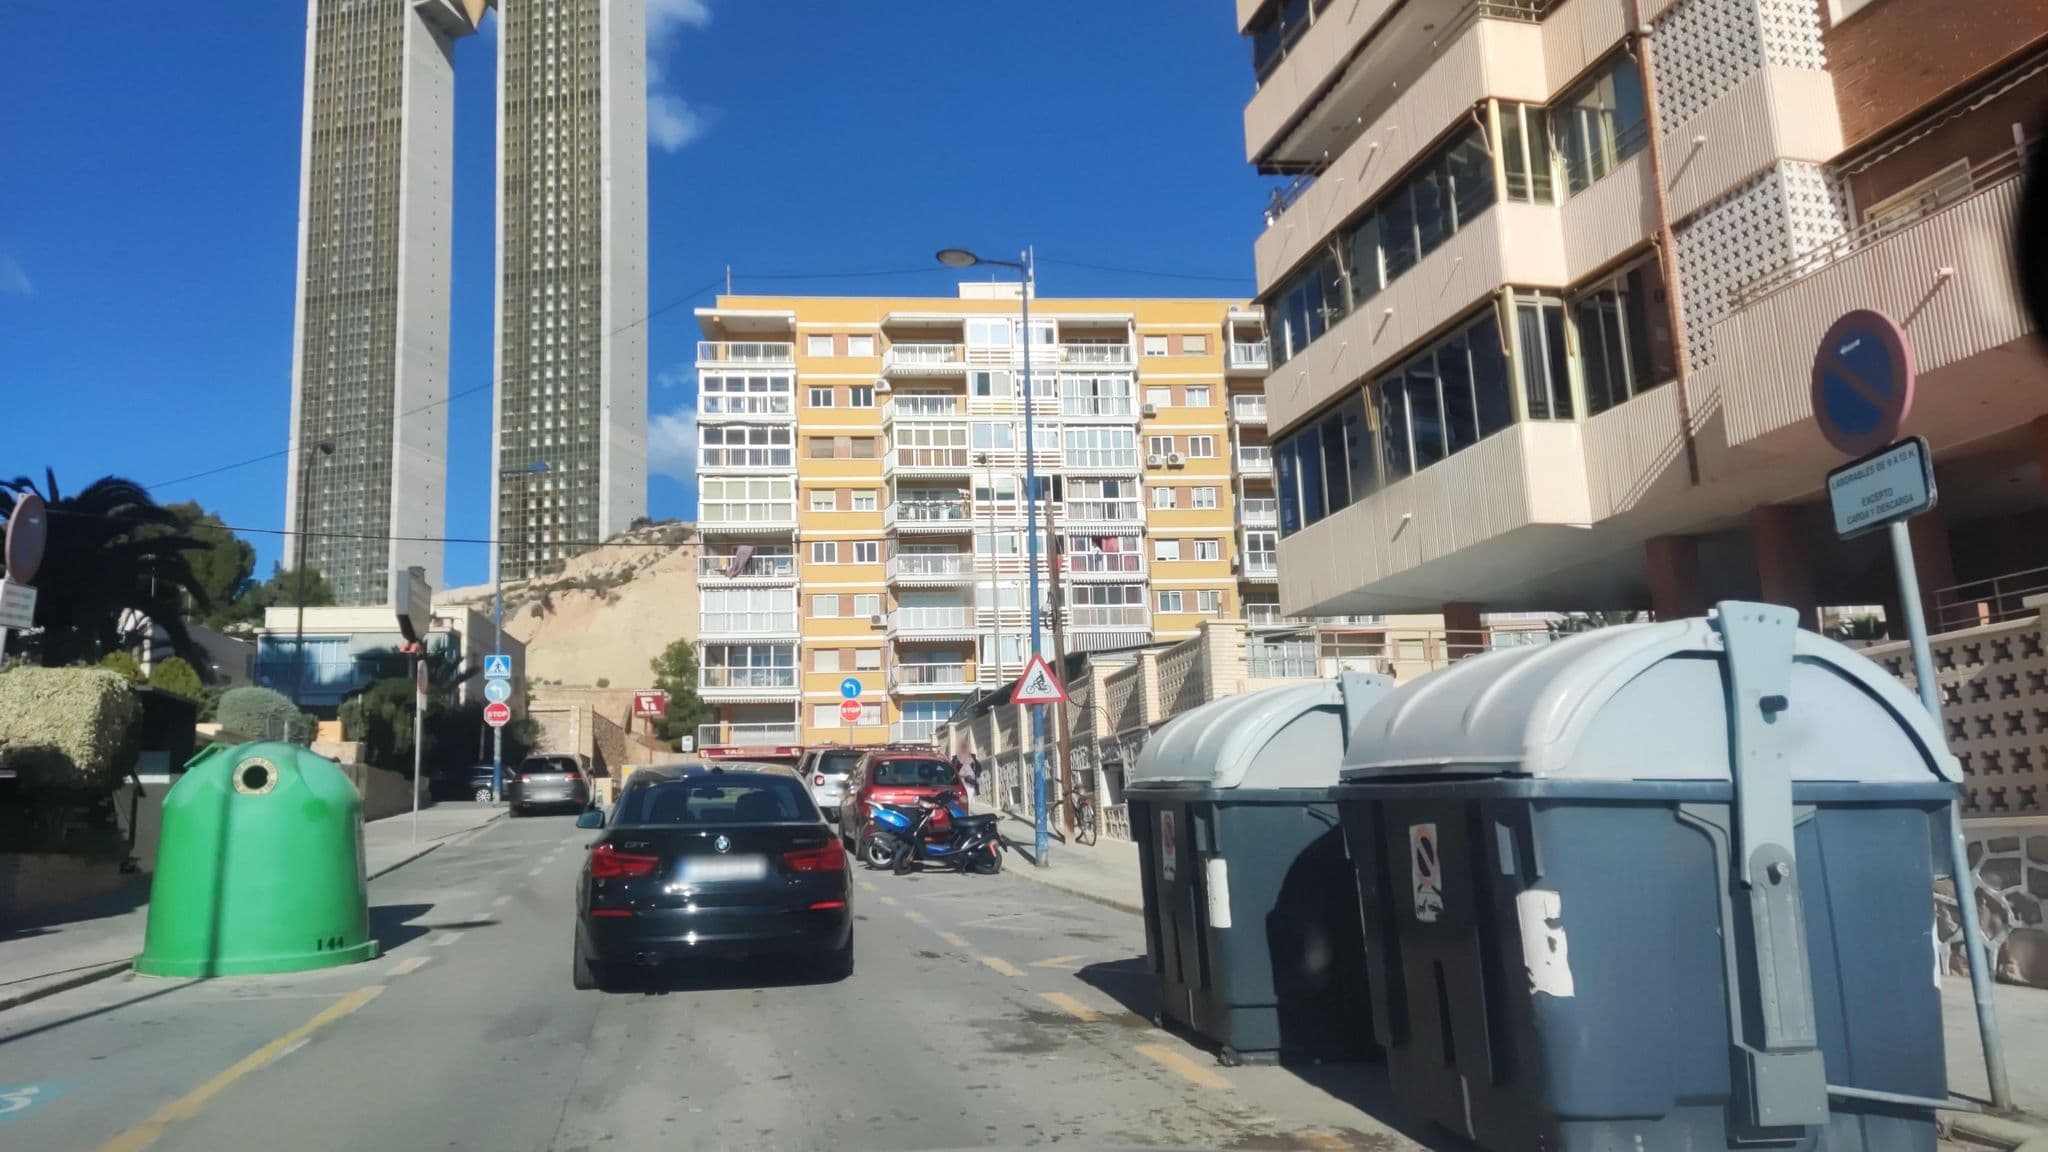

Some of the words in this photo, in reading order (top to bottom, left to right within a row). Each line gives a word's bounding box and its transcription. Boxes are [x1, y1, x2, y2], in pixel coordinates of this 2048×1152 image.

[1876, 461, 1886, 472] DE
[1861, 487, 1893, 506] EXCEPTO
[1846, 510, 1870, 525] CARGA
[1876, 493, 1915, 514] DESCARGA
[487, 710, 508, 719] STOP
[842, 706, 861, 714] STOP
